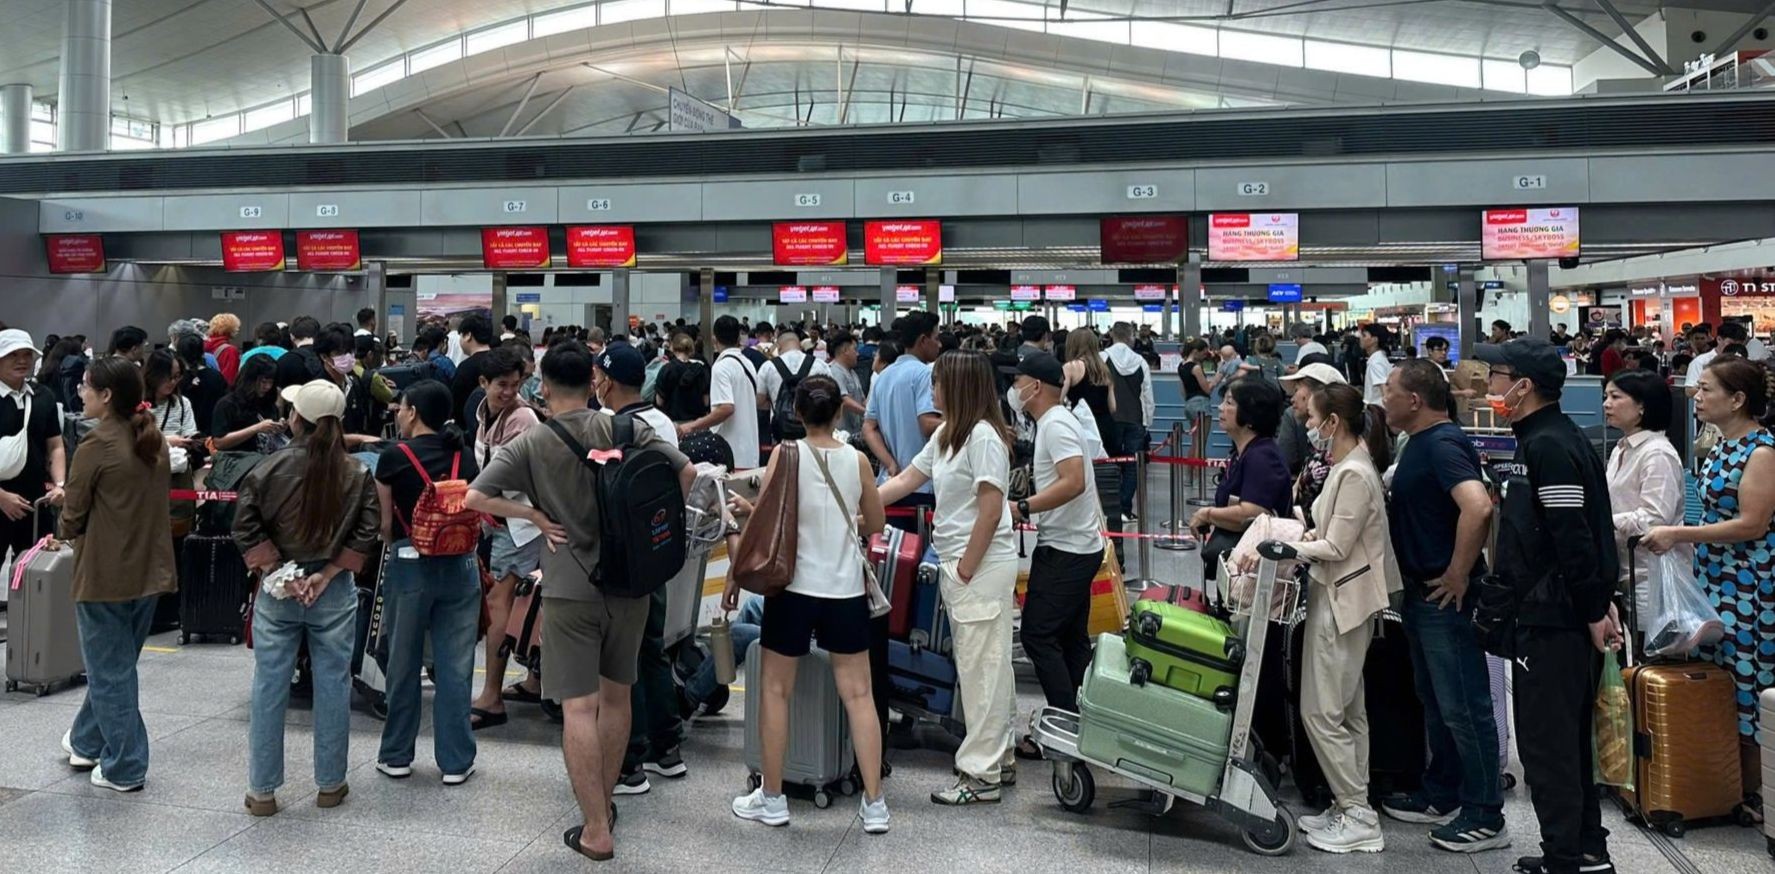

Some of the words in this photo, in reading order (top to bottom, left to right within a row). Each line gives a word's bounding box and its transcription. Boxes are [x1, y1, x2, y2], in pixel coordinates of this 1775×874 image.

[1519, 176, 1542, 188] G-1
[1132, 186, 1154, 196] G-3
[1244, 184, 1265, 194] G-2
[800, 195, 818, 204] G-5
[892, 193, 911, 202] G-4
[508, 202, 524, 211] G-7
[592, 200, 608, 209] G-6
[244, 208, 259, 216] G-9
[320, 206, 336, 216] G-8
[196, 490, 218, 500] TIA
